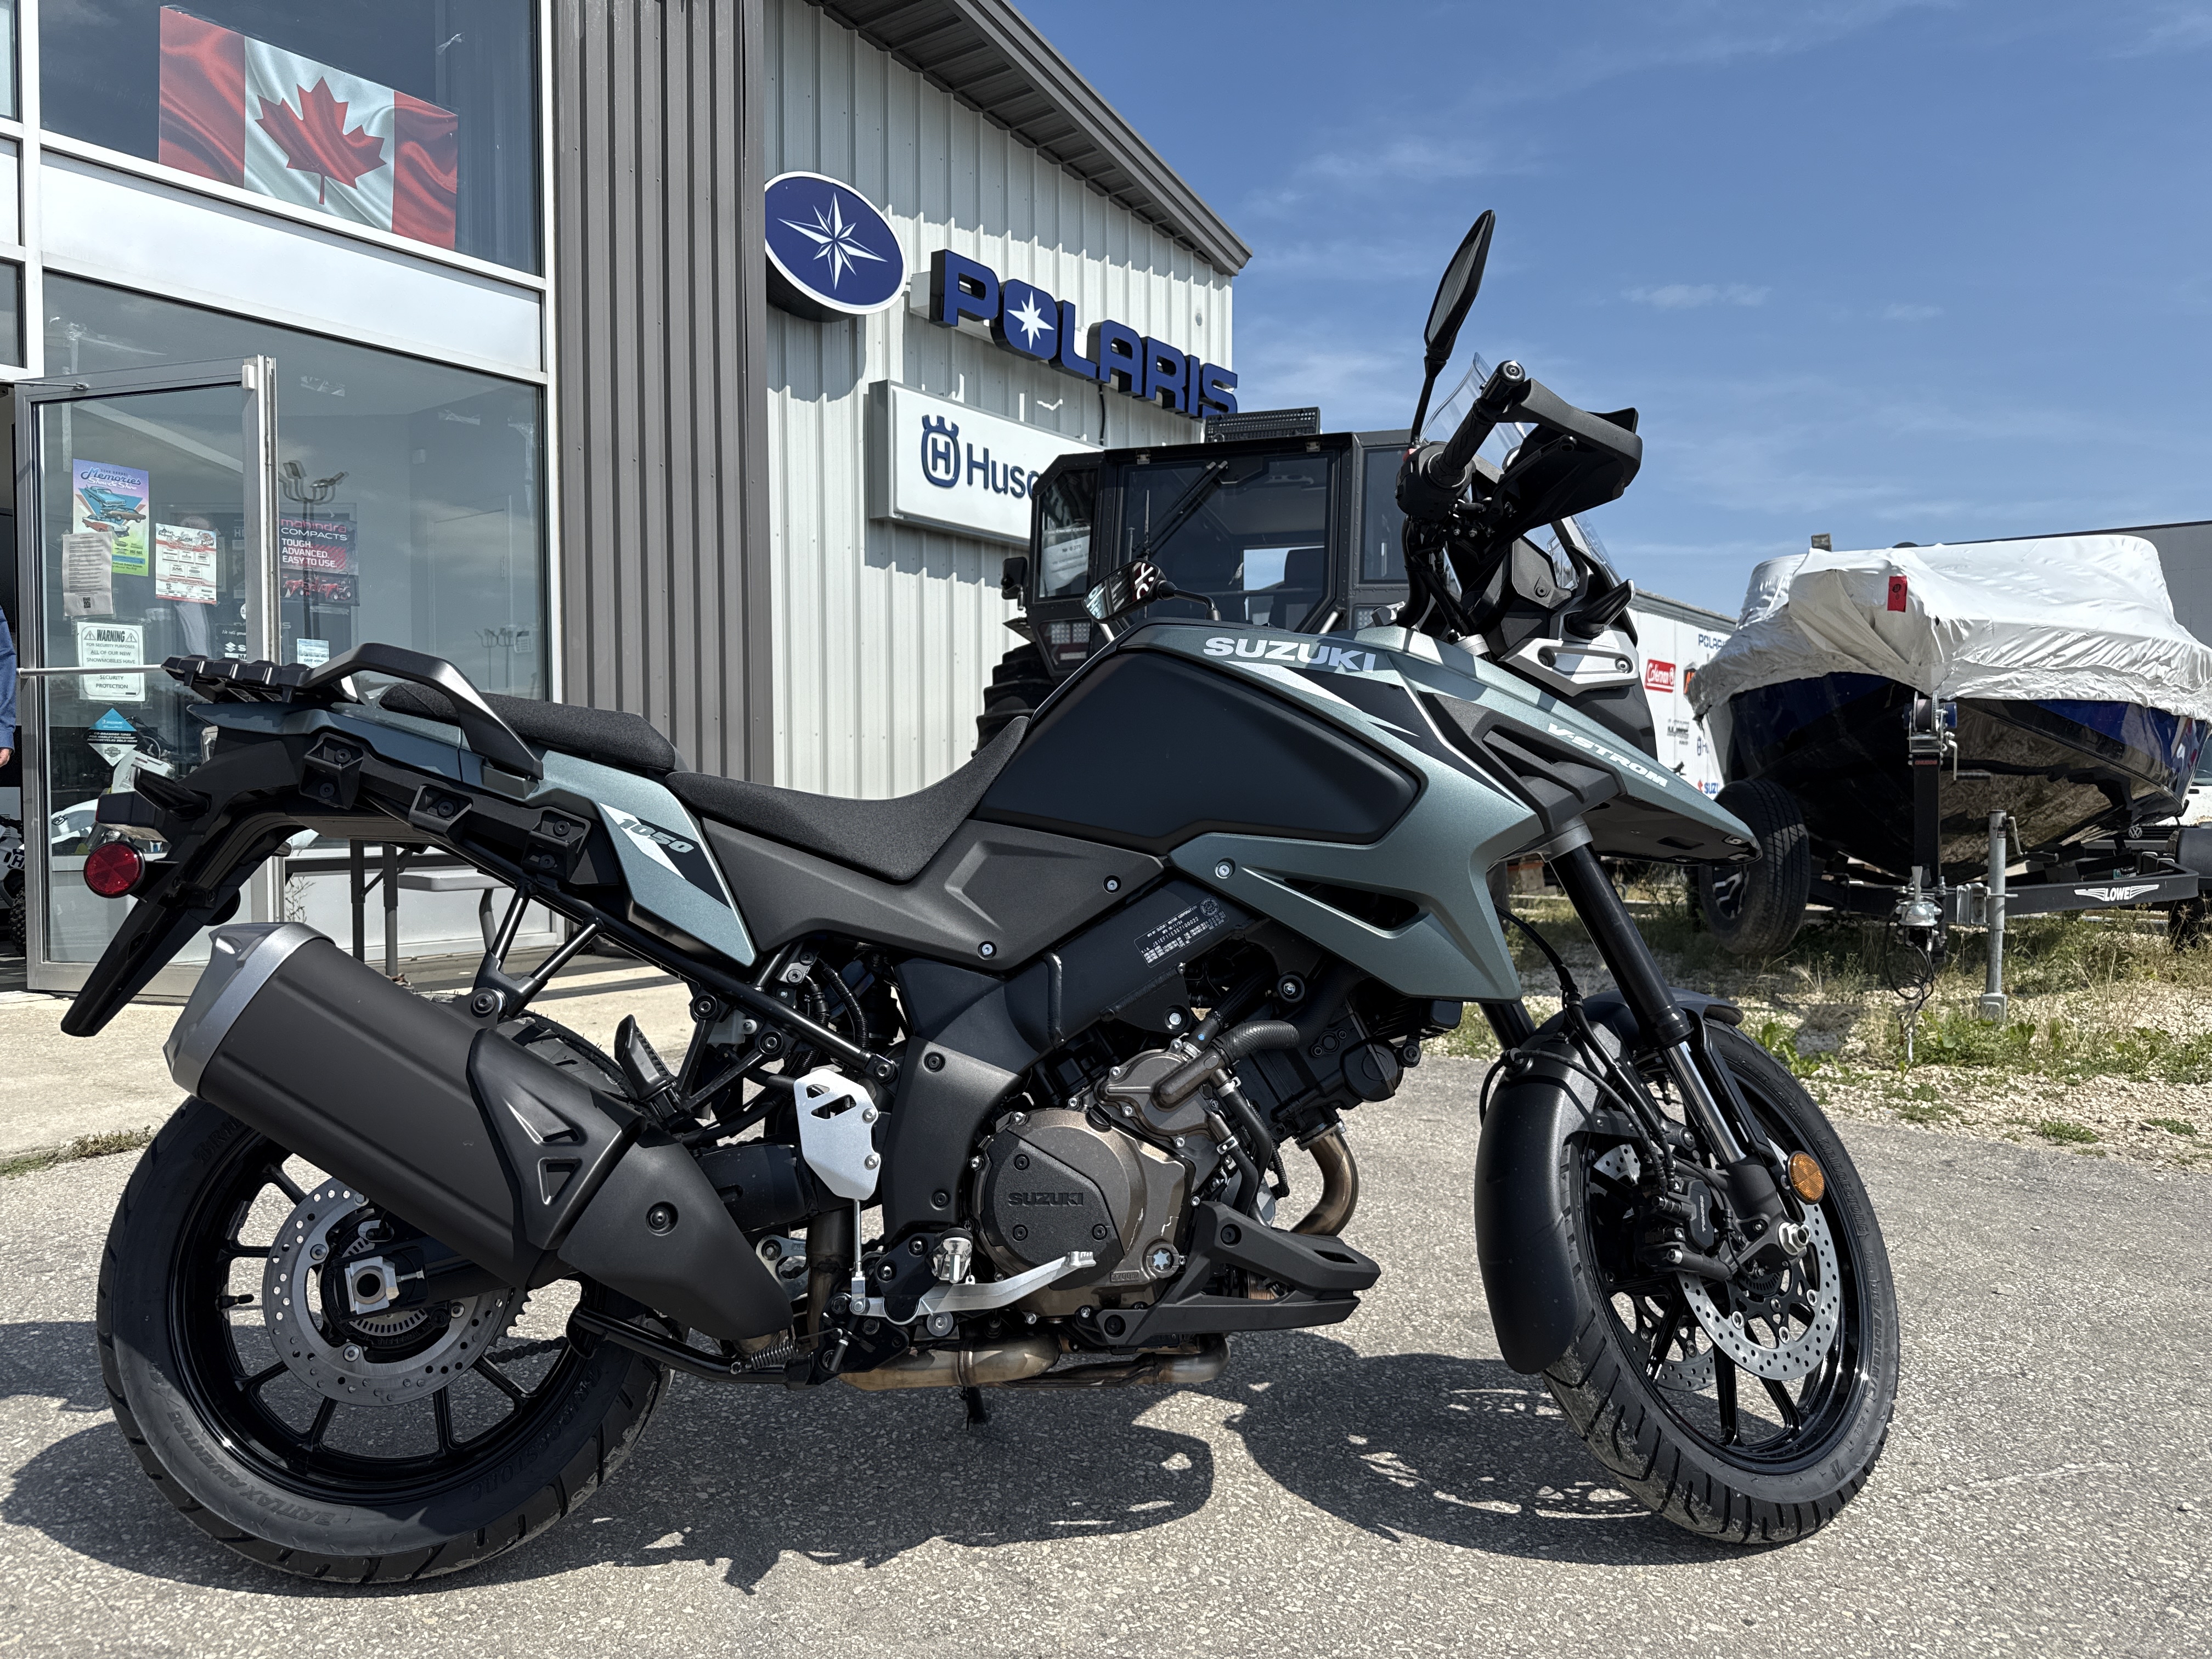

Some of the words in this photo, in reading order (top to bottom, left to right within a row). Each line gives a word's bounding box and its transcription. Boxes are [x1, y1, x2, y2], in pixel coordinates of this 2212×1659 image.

[931, 250, 1238, 418] POLARIS
[81, 466, 142, 486] Memories
[280, 518, 347, 533] mahindra
[281, 527, 347, 541] COMPACTS
[281, 538, 314, 549] TOUGH.
[282, 546, 330, 558] ADVANCED.
[283, 555, 305, 565] EASY
[318, 559, 337, 568] USE.
[97, 629, 125, 642] WARNING
[1203, 637, 1376, 695] SUZUKI
[1647, 662, 1669, 685] Coleman
[1548, 723, 1668, 787] V-STROM
[619, 819, 695, 853] 1050
[2104, 886, 2131, 902] LOWE
[1008, 1192, 1084, 1207] SUZUKI
